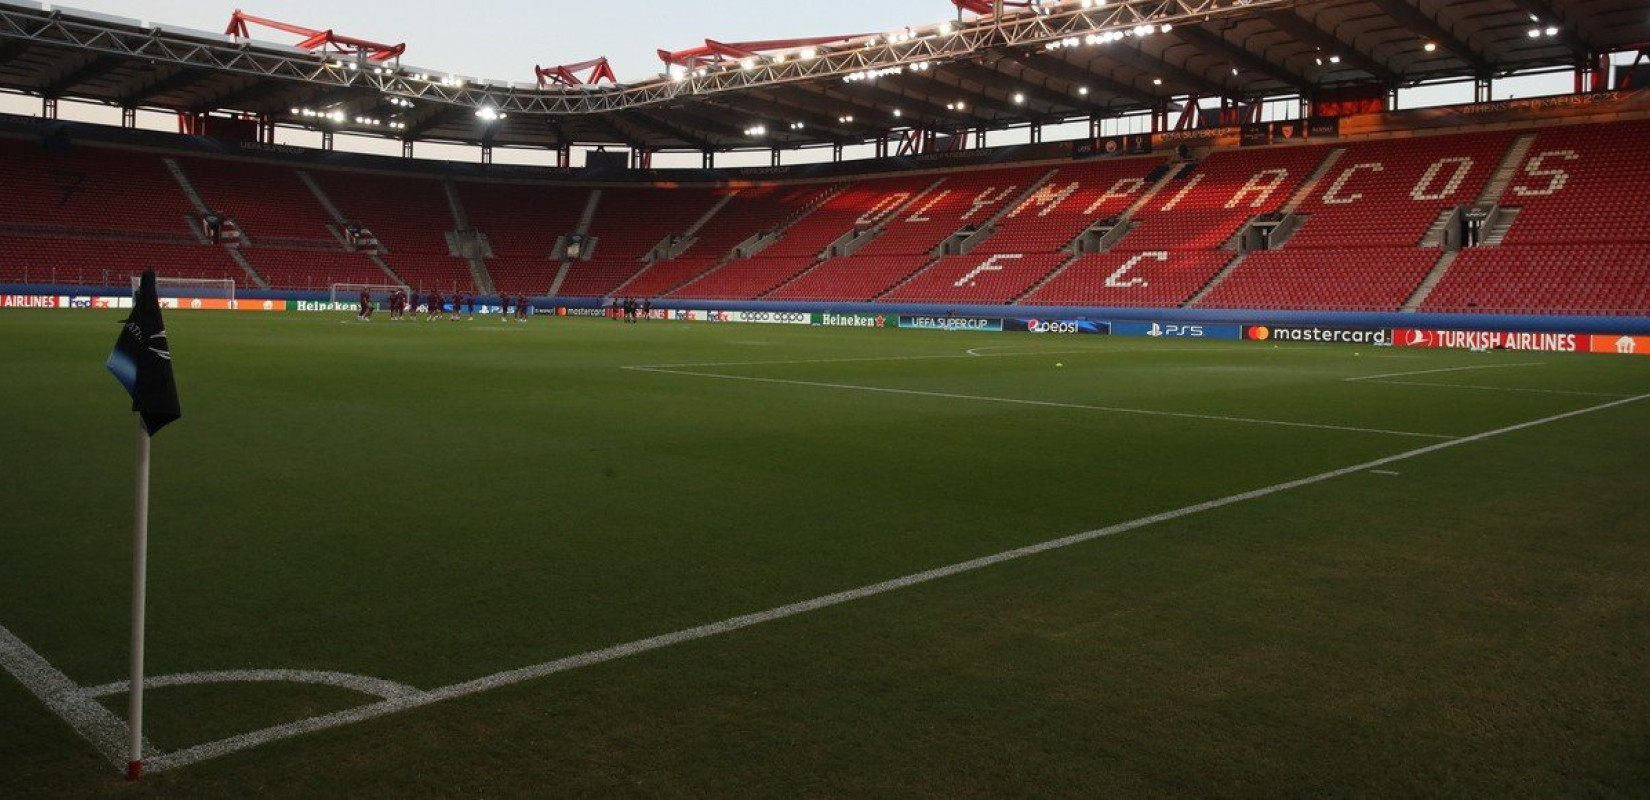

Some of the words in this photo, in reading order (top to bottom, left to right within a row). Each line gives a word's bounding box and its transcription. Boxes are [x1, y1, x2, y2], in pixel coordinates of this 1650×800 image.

[5, 295, 55, 307] AIRLINES
[297, 301, 358, 311] Heineken
[740, 311, 769, 323] oppo
[773, 312, 803, 324] oppo
[822, 313, 875, 327] Heineken
[912, 317, 935, 328] UEFA
[937, 318, 966, 329] SUPER
[968, 319, 988, 329] CUP
[1042, 320, 1078, 333] pepsi
[1165, 324, 1204, 336] PS5
[1273, 327, 1386, 343] mastercard
[1437, 330, 1501, 349] TURKISH
[1504, 333, 1577, 352] AIRLINES
